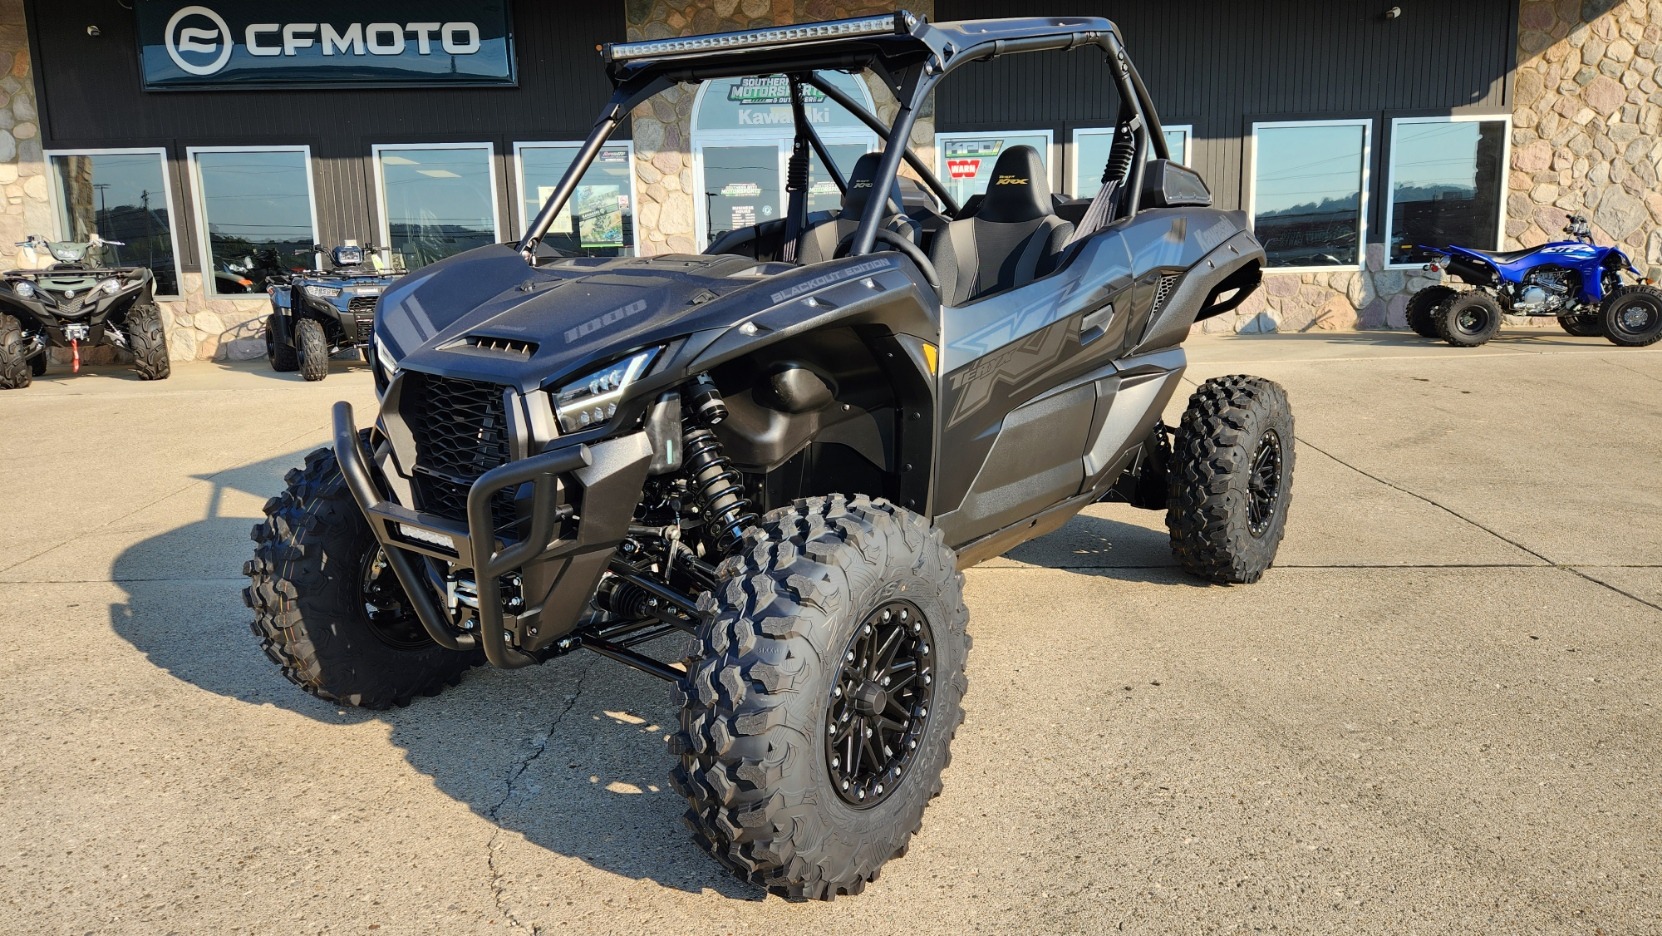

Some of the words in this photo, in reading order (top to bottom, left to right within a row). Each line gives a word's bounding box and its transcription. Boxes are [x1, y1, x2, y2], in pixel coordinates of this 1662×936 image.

[245, 21, 481, 56] CFMOTO
[739, 107, 830, 125] Kawaki
[951, 165, 976, 174] WARN
[770, 272, 841, 303] BLACKOUT
[845, 258, 891, 277] EDITION
[564, 299, 648, 344] 1000
